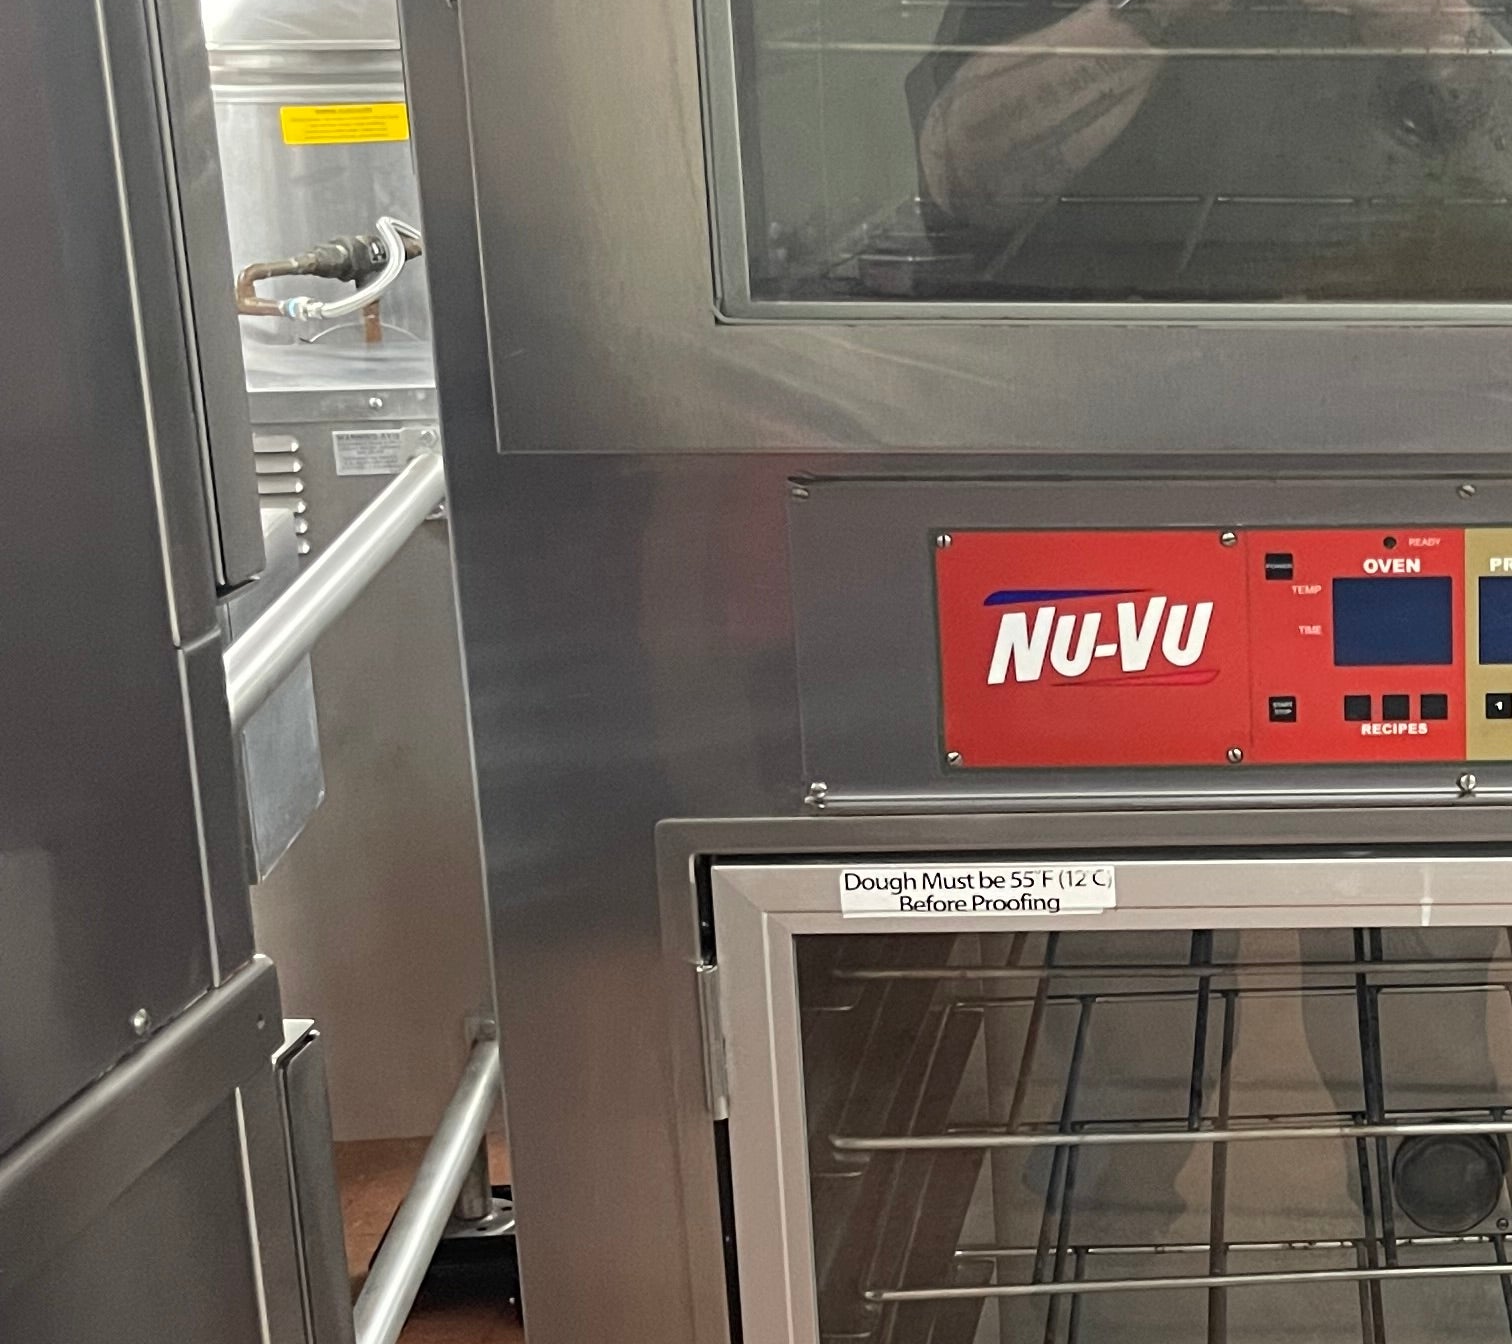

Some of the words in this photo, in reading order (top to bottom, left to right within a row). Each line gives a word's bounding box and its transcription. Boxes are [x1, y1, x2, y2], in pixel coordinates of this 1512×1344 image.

[1408, 537, 1441, 547] READY
[1362, 558, 1421, 574] OVEN
[1292, 584, 1322, 595] TEMP
[1298, 625, 1322, 635] TIME
[1361, 723, 1429, 735] RECIPES
[844, 872, 917, 894] Dough
[922, 872, 974, 891] Must
[979, 871, 1005, 889] be
[899, 895, 967, 912] Before
[972, 894, 1060, 913] Proofing
